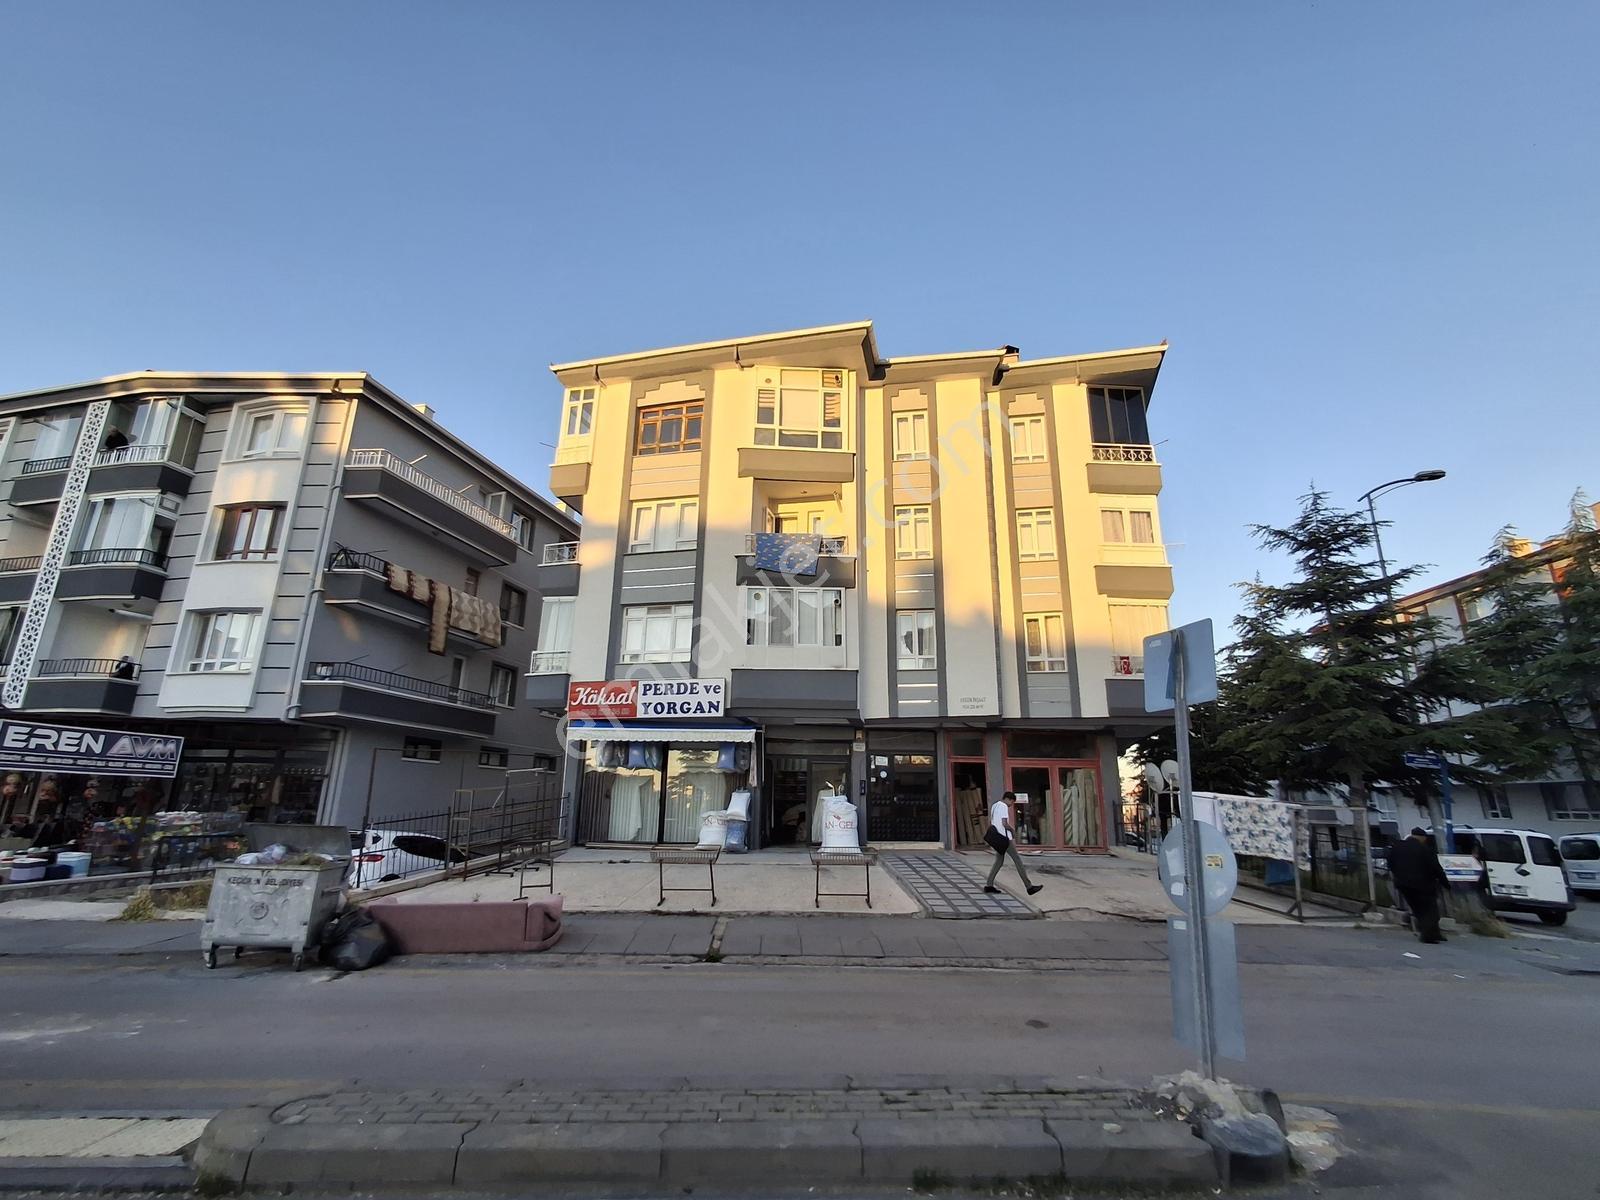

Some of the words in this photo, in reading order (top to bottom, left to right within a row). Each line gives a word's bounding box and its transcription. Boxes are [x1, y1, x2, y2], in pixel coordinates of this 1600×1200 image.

[571, 686, 637, 706] Köksal
[642, 682, 700, 696] PERDE
[703, 684, 722, 695] ve
[641, 700, 721, 715] YORGAN
[3, 725, 106, 754] EREN
[106, 735, 178, 760] AVM
